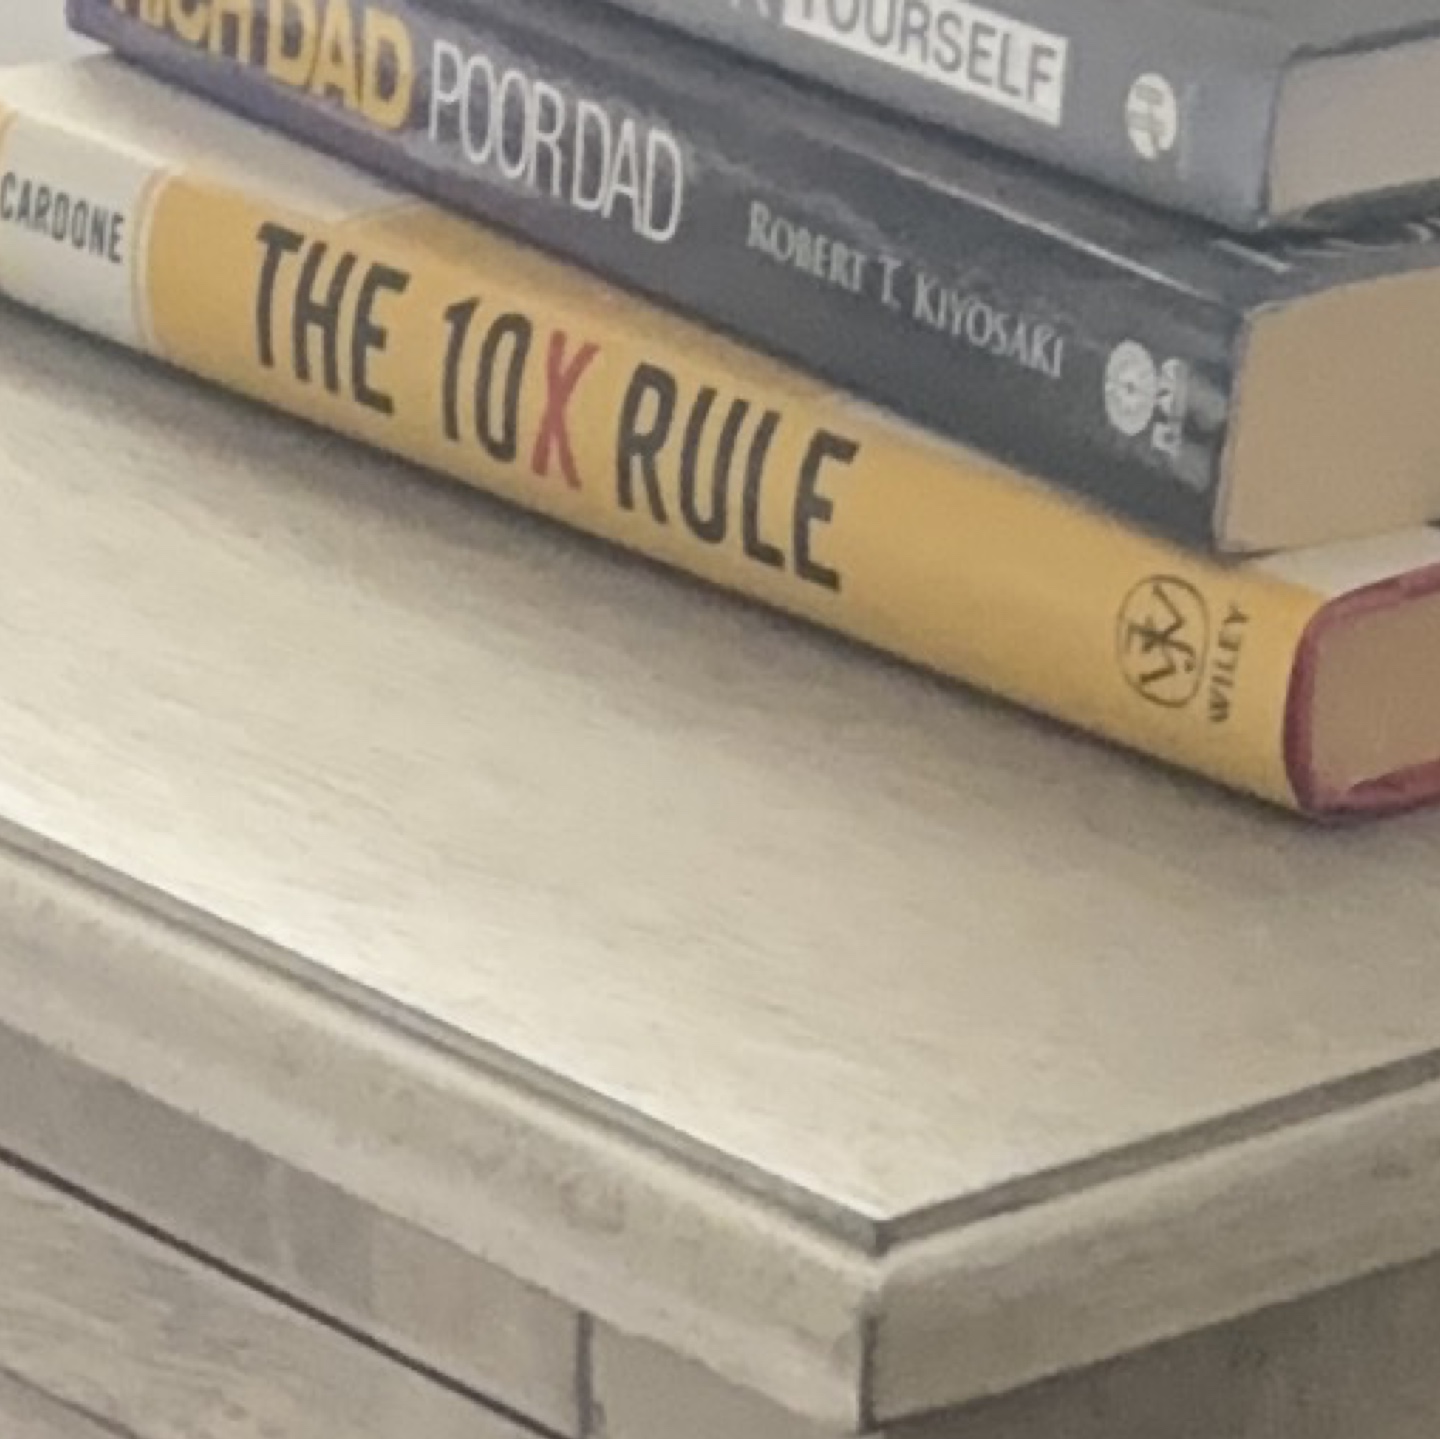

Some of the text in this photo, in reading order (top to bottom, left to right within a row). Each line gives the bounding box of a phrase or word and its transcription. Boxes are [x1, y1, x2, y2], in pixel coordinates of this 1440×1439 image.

[265, 0, 414, 131] DAD
[428, 39, 684, 242] POOR DAD
[746, 200, 867, 293] ROBERT
[913, 270, 1064, 379] KIYOSAKI
[256, 222, 861, 594] THE 10X RULE
[1208, 601, 1251, 723] WILEY
